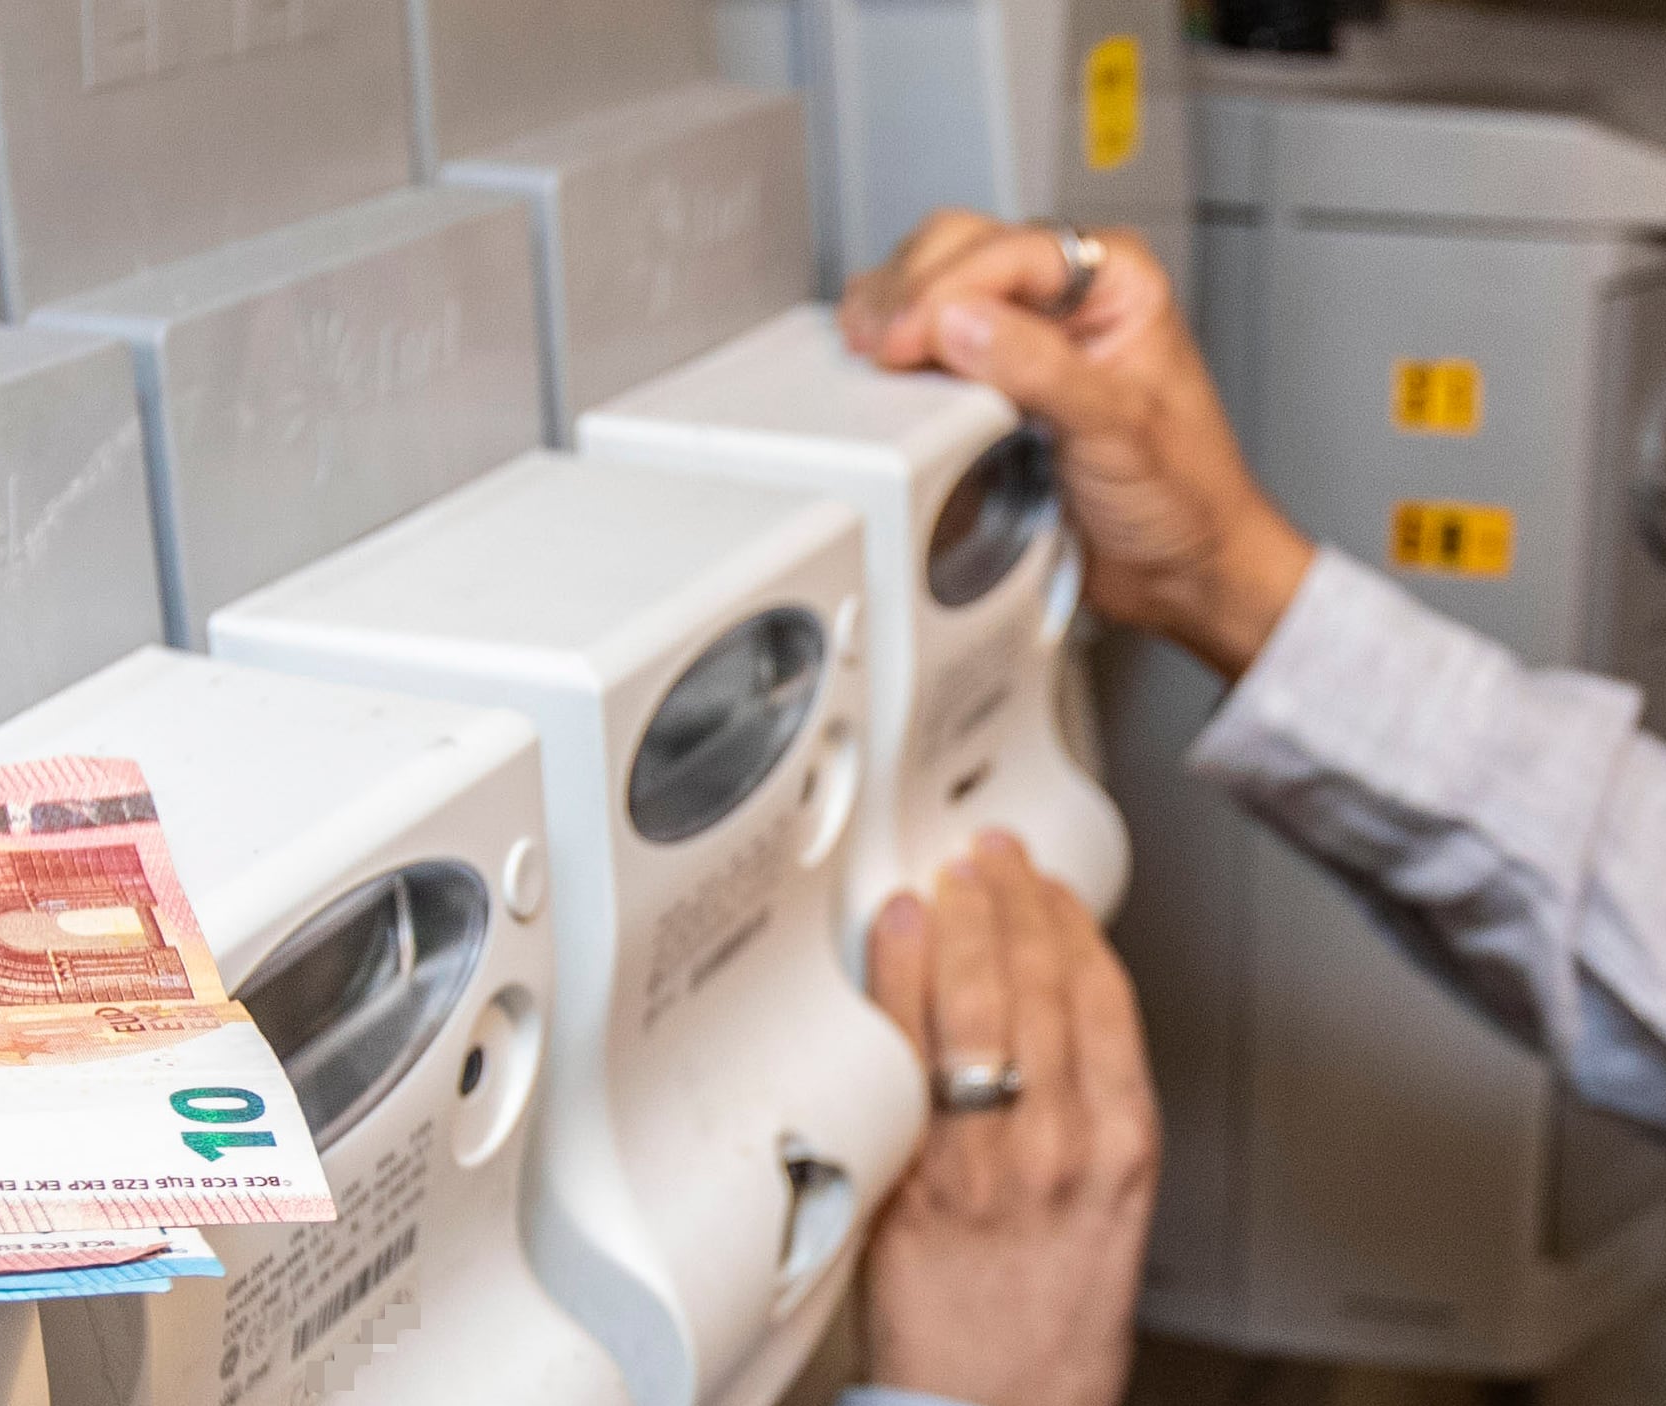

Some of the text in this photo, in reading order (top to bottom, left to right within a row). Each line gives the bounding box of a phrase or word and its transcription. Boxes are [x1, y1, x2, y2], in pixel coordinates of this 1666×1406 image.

[169, 1086, 277, 1162] 10
[24, 1180, 61, 1192] EKT
[68, 1179, 106, 1191] EKP
[113, 1178, 149, 1190] EZB
[201, 1177, 238, 1189] ECB
[244, 1176, 280, 1188] BCE
